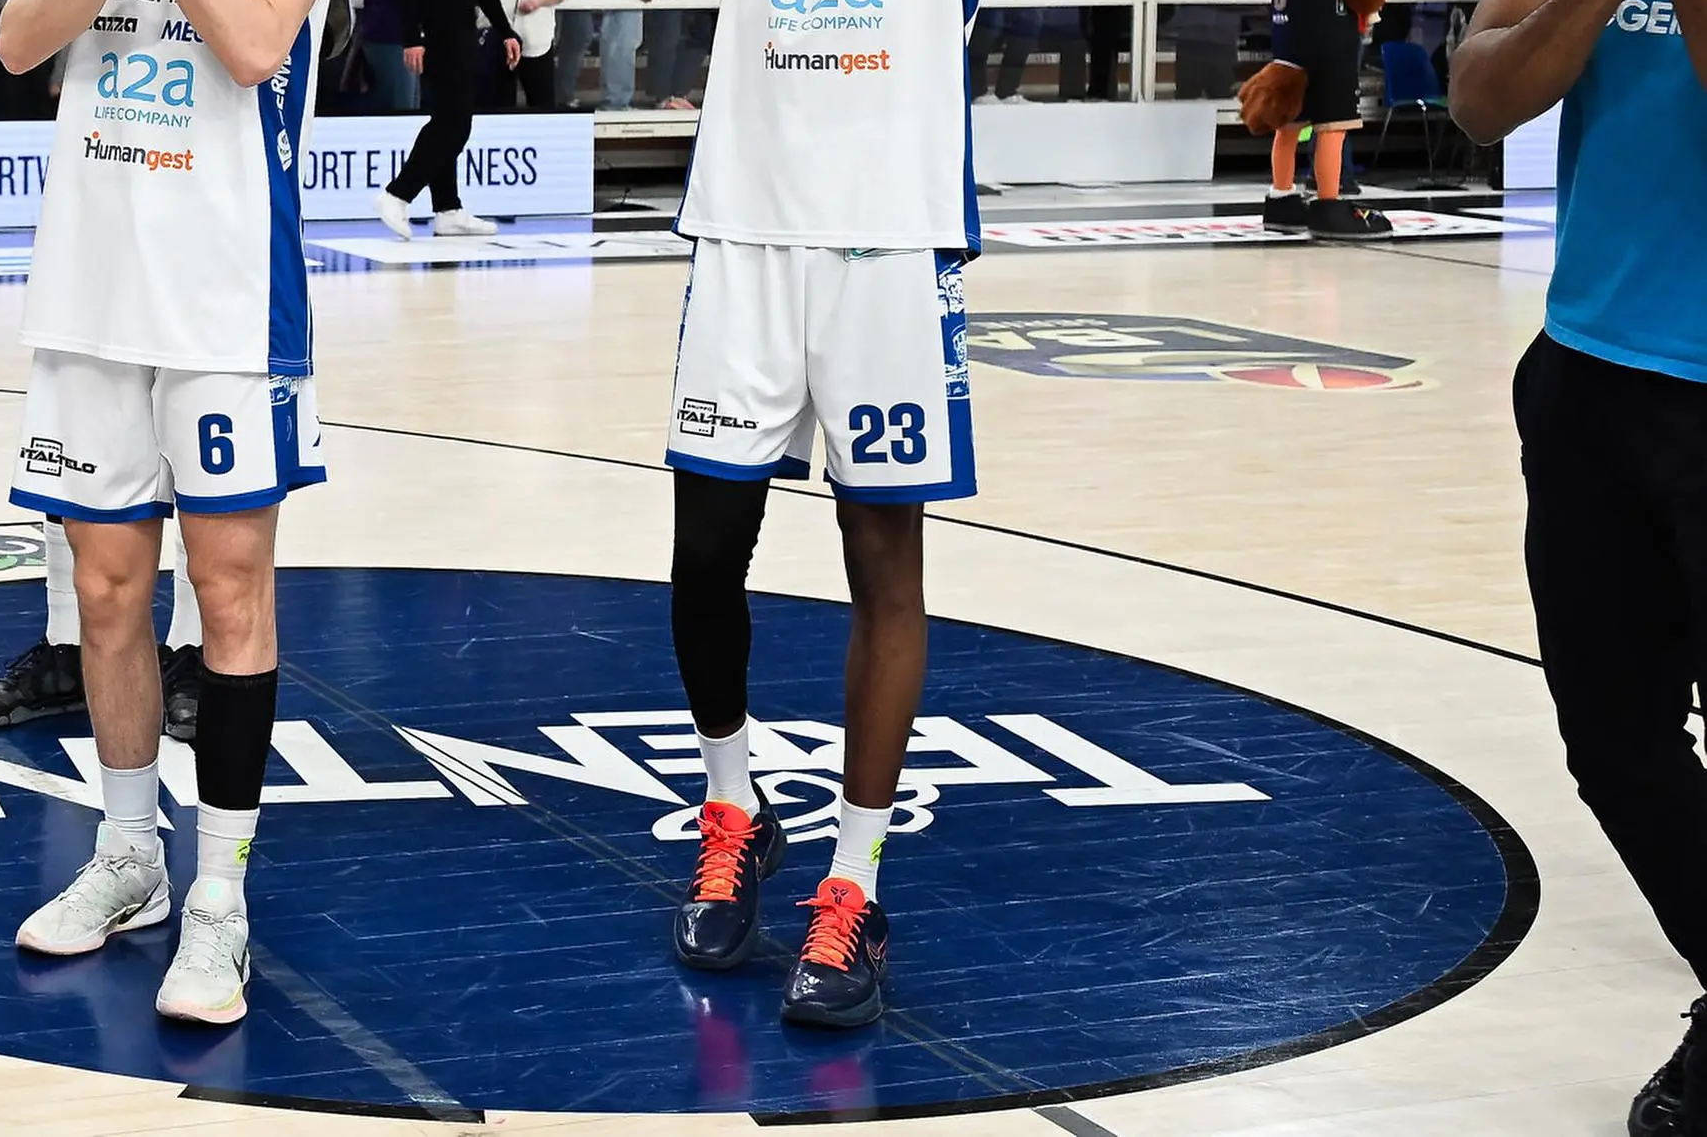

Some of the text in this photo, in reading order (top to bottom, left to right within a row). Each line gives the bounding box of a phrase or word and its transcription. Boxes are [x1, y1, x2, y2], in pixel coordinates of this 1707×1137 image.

[768, 17, 796, 32] LIFE
[97, 51, 195, 108] a2a
[94, 105, 192, 128] LIFE COMPANY
[84, 130, 195, 170] Humangest
[466, 147, 538, 187] NESS
[197, 412, 236, 476] 6
[848, 401, 928, 465] 23
